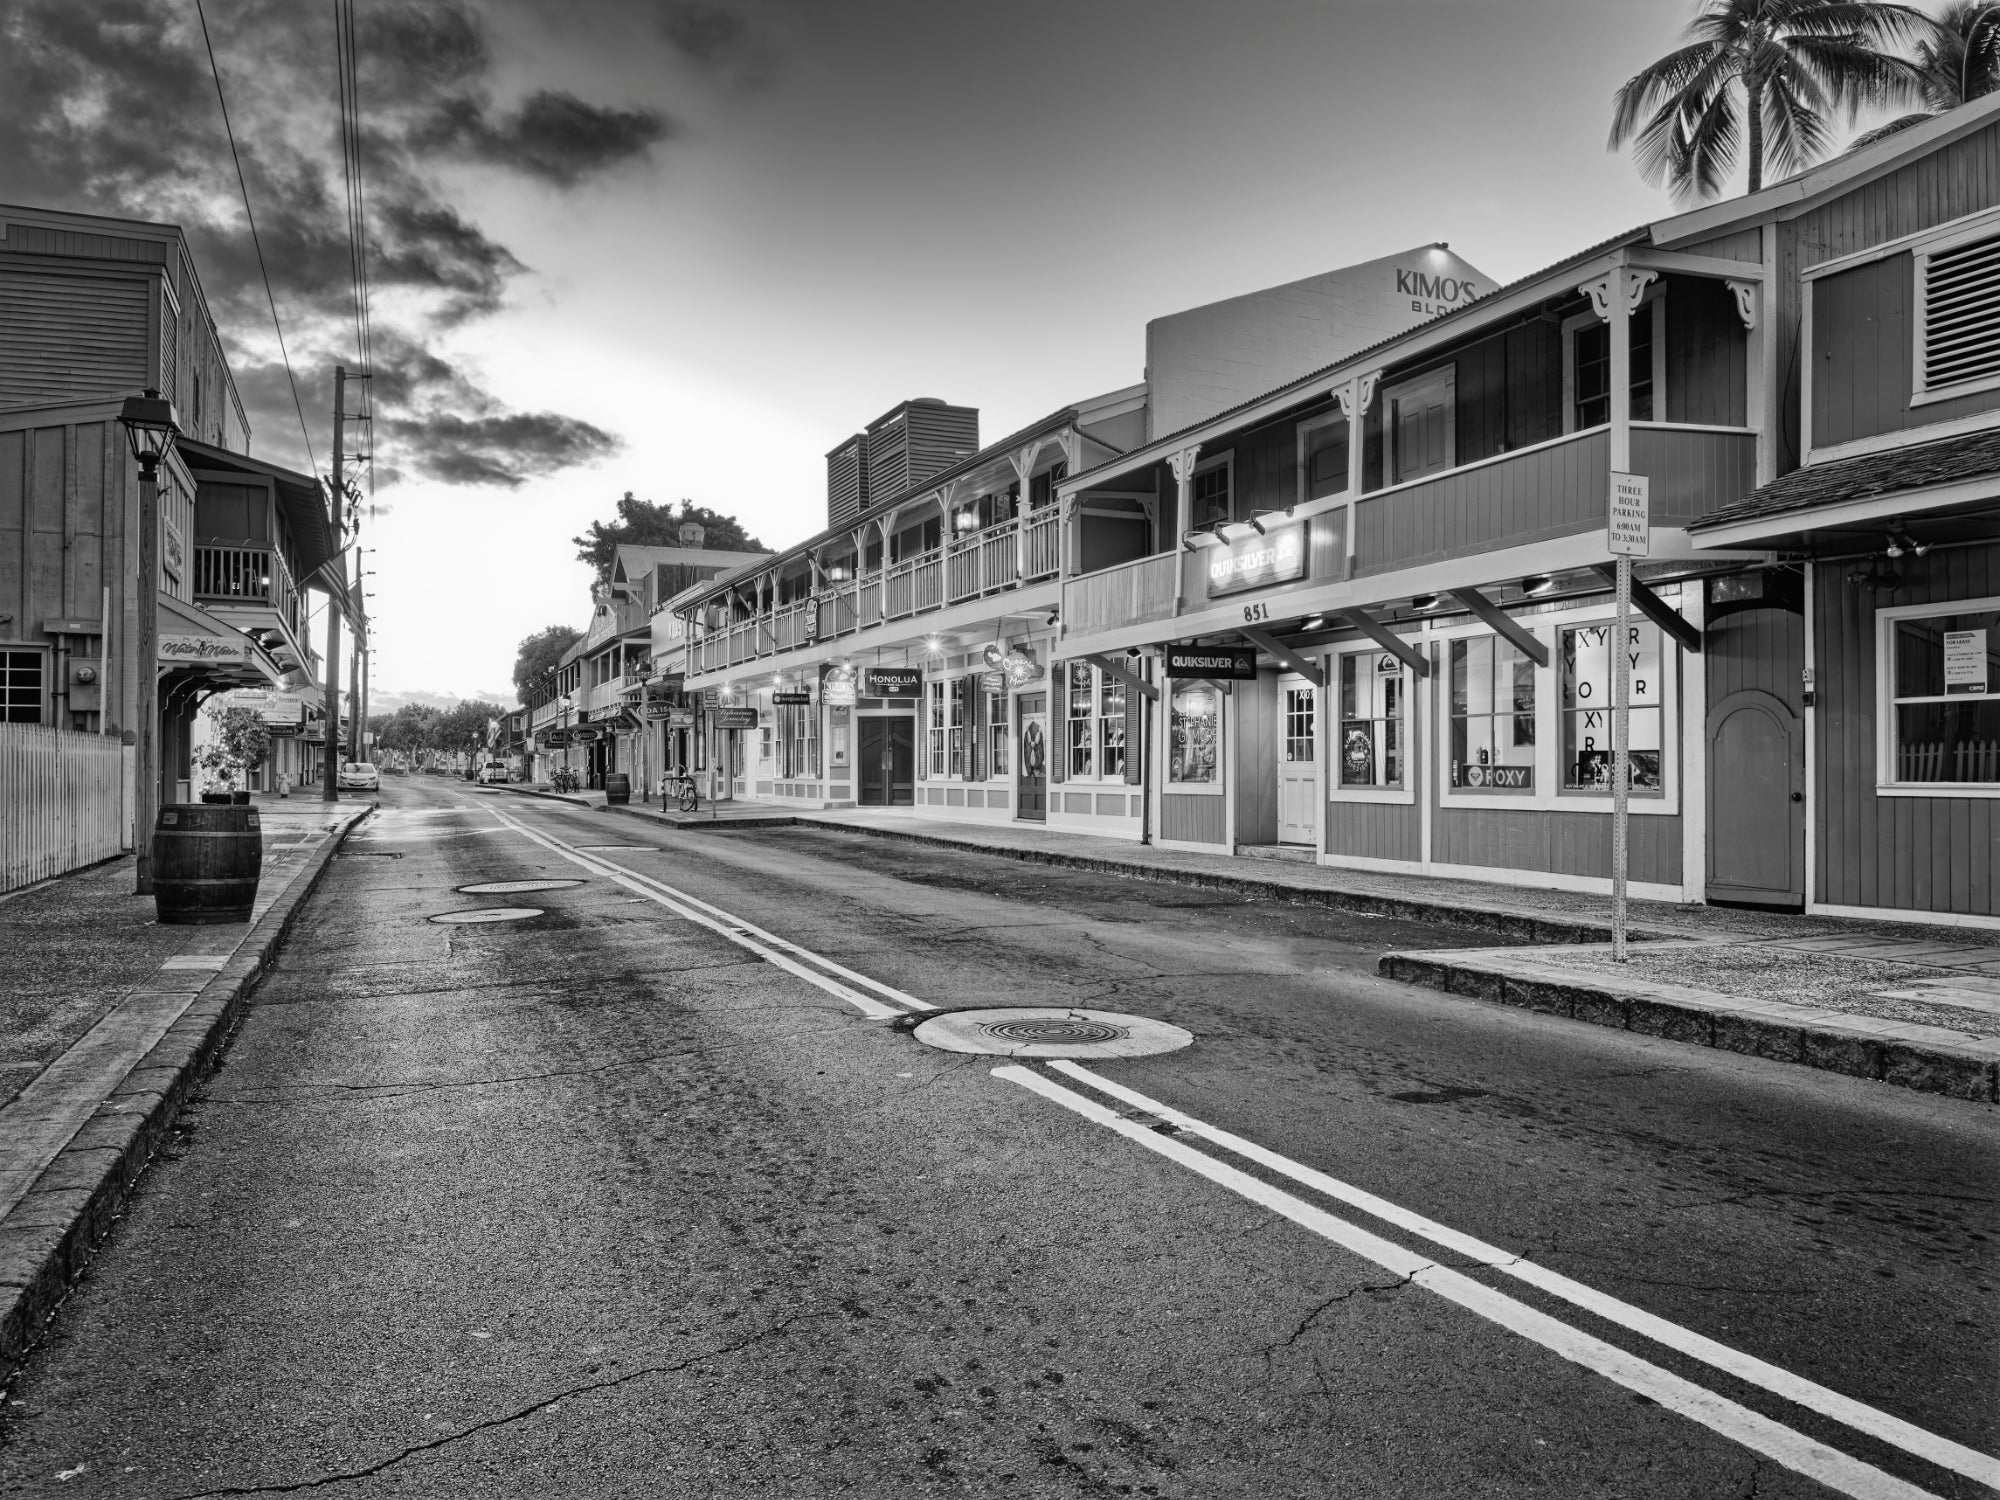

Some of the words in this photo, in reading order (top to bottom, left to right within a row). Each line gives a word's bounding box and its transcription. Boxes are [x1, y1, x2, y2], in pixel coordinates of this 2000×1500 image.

[1396, 268, 1476, 305] KIMO'S
[1411, 300, 1456, 317] BLD
[1616, 484, 1643, 496] THREE
[1618, 496, 1640, 507] HOUR
[1612, 507, 1646, 519] PARKING
[1616, 522, 1641, 532] 6:00AM
[1611, 532, 1621, 542] TO
[1210, 548, 1275, 578] QUIKSILVER
[1243, 602, 1269, 622] 851
[1172, 655, 1232, 668] QUIKSILVER
[869, 674, 918, 684] HONOLUA
[1485, 769, 1526, 786] ROXY
